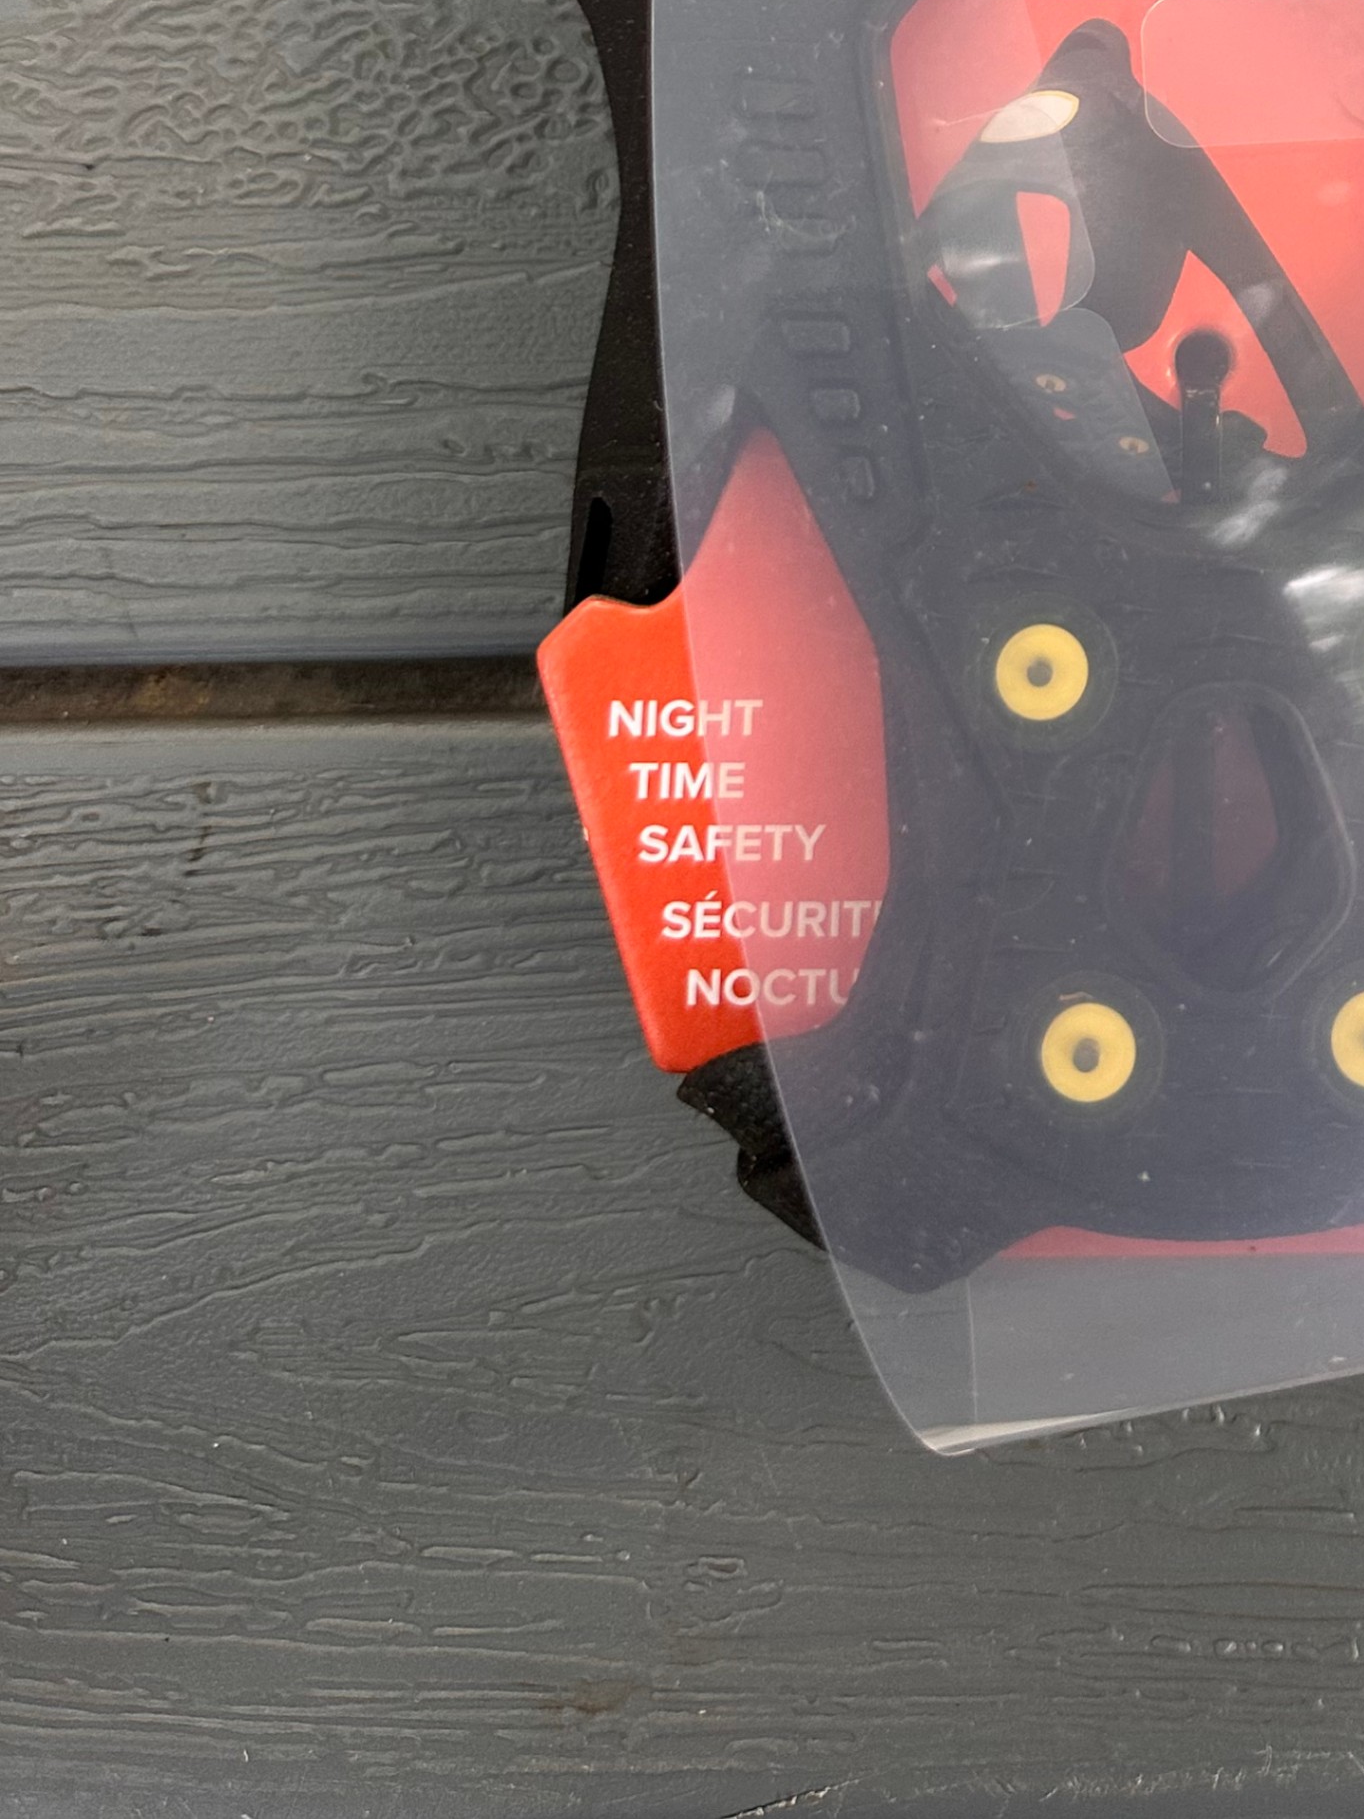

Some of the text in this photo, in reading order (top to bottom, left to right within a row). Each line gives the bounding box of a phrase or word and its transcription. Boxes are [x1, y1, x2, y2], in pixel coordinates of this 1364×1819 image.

[608, 699, 763, 737] NIGHT
[629, 761, 745, 800] TIME
[637, 824, 826, 863] SAFETY
[661, 890, 882, 939] SÉCURIT
